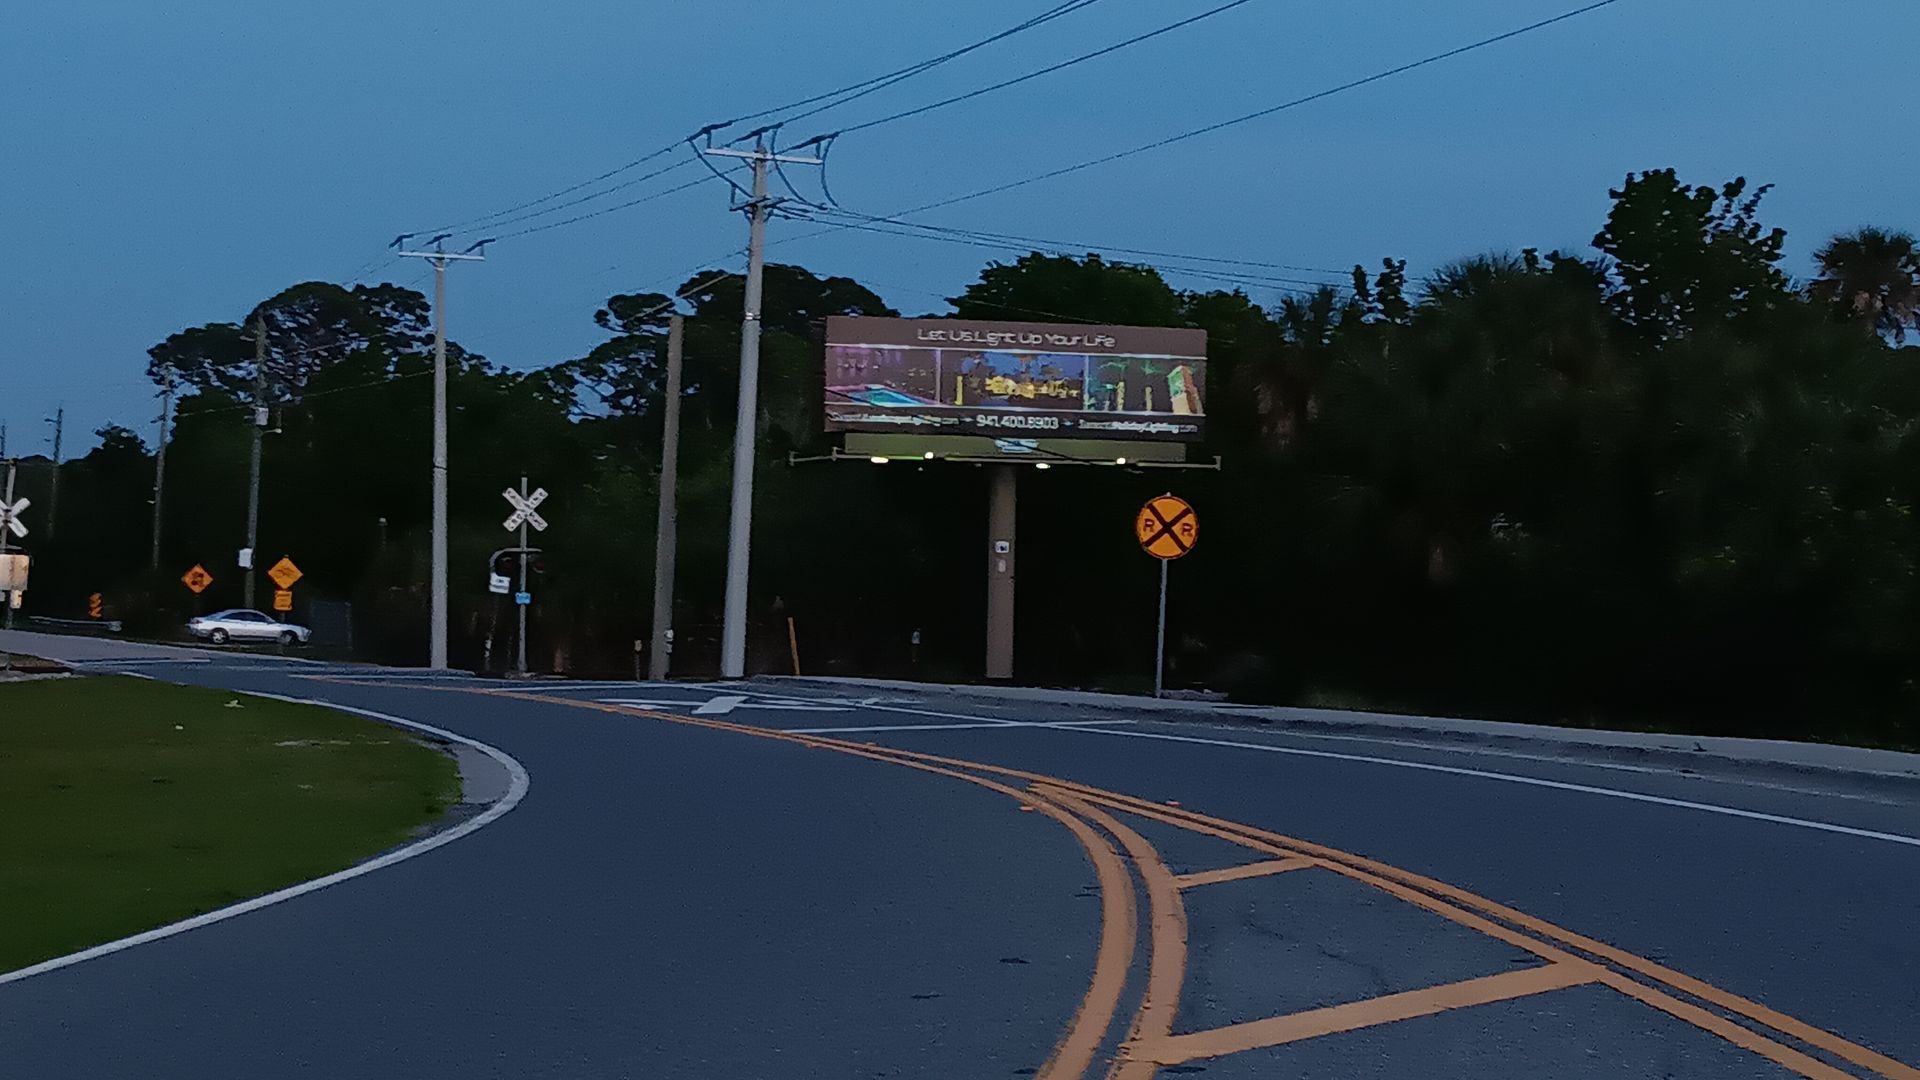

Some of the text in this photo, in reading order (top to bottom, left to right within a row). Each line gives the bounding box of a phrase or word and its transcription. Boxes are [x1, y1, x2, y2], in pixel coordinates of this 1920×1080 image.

[917, 328, 946, 341] Let
[949, 330, 972, 342] Us
[975, 330, 1017, 347] Light
[1019, 332, 1043, 346] Up
[1044, 333, 1082, 346] Your
[1143, 518, 1194, 537] R R
